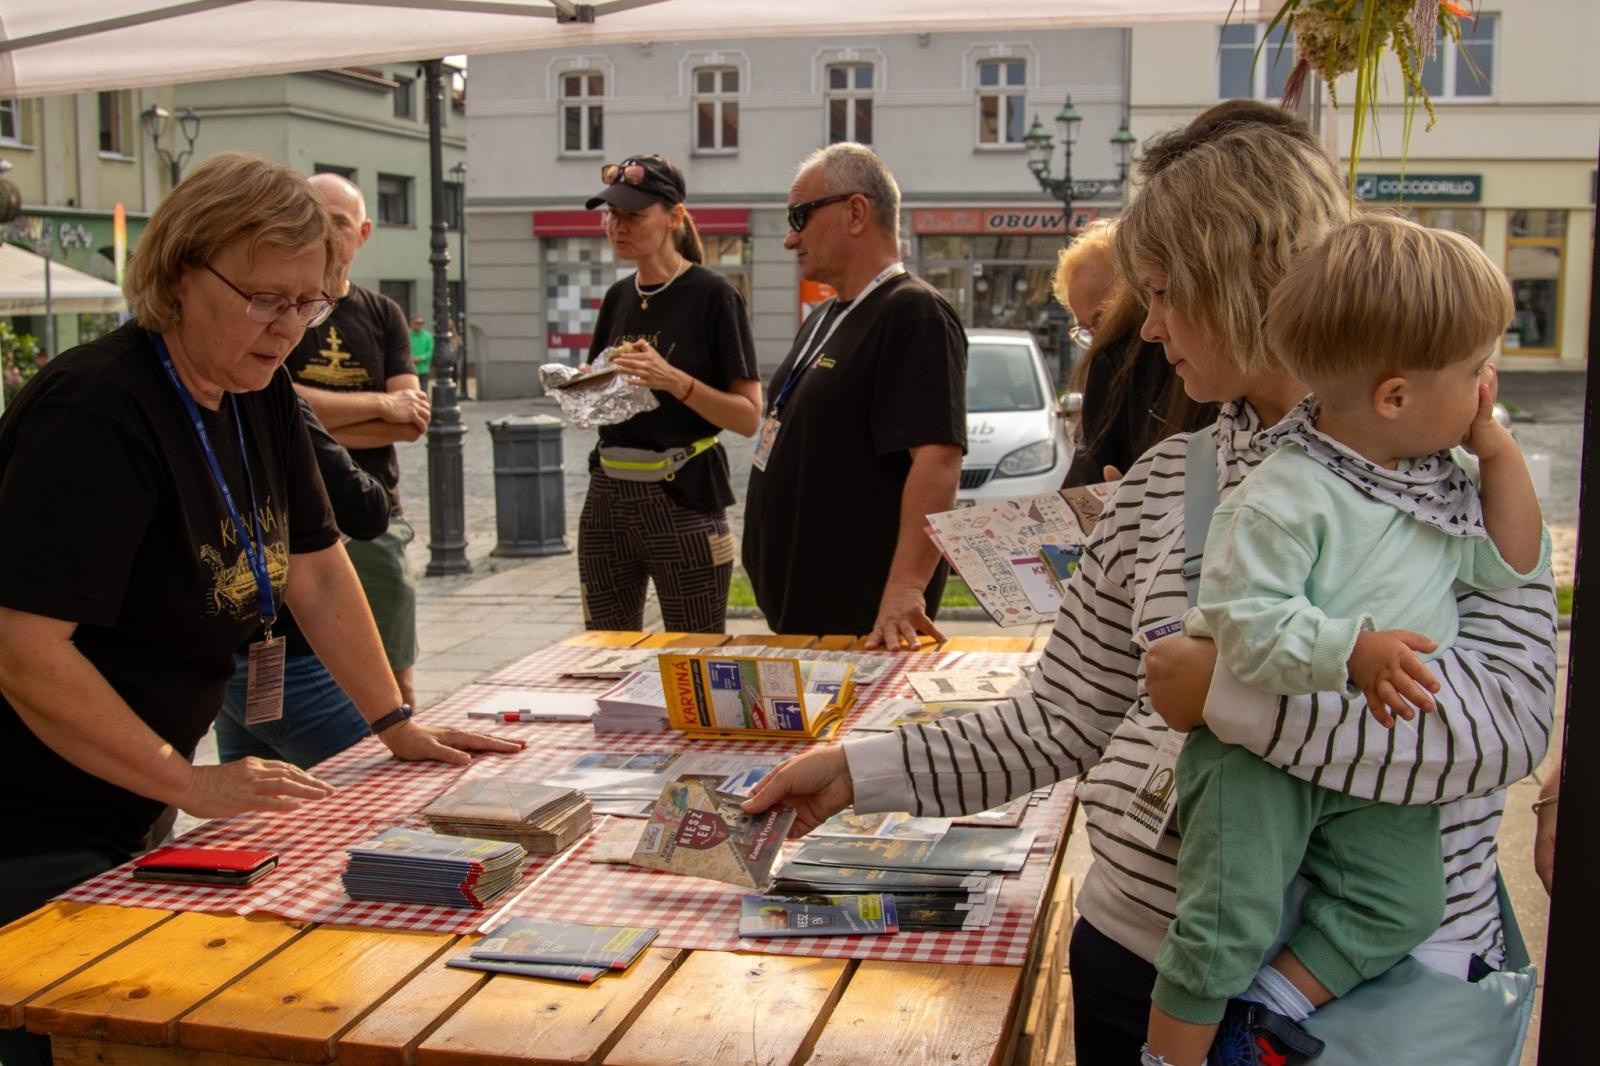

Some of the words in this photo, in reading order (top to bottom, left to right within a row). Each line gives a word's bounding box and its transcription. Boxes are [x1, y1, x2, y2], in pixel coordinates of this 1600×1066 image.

[989, 213, 1089, 229] OBUWE
[671, 660, 698, 726] KARVINÁ
[679, 812, 703, 845] KIESZ
